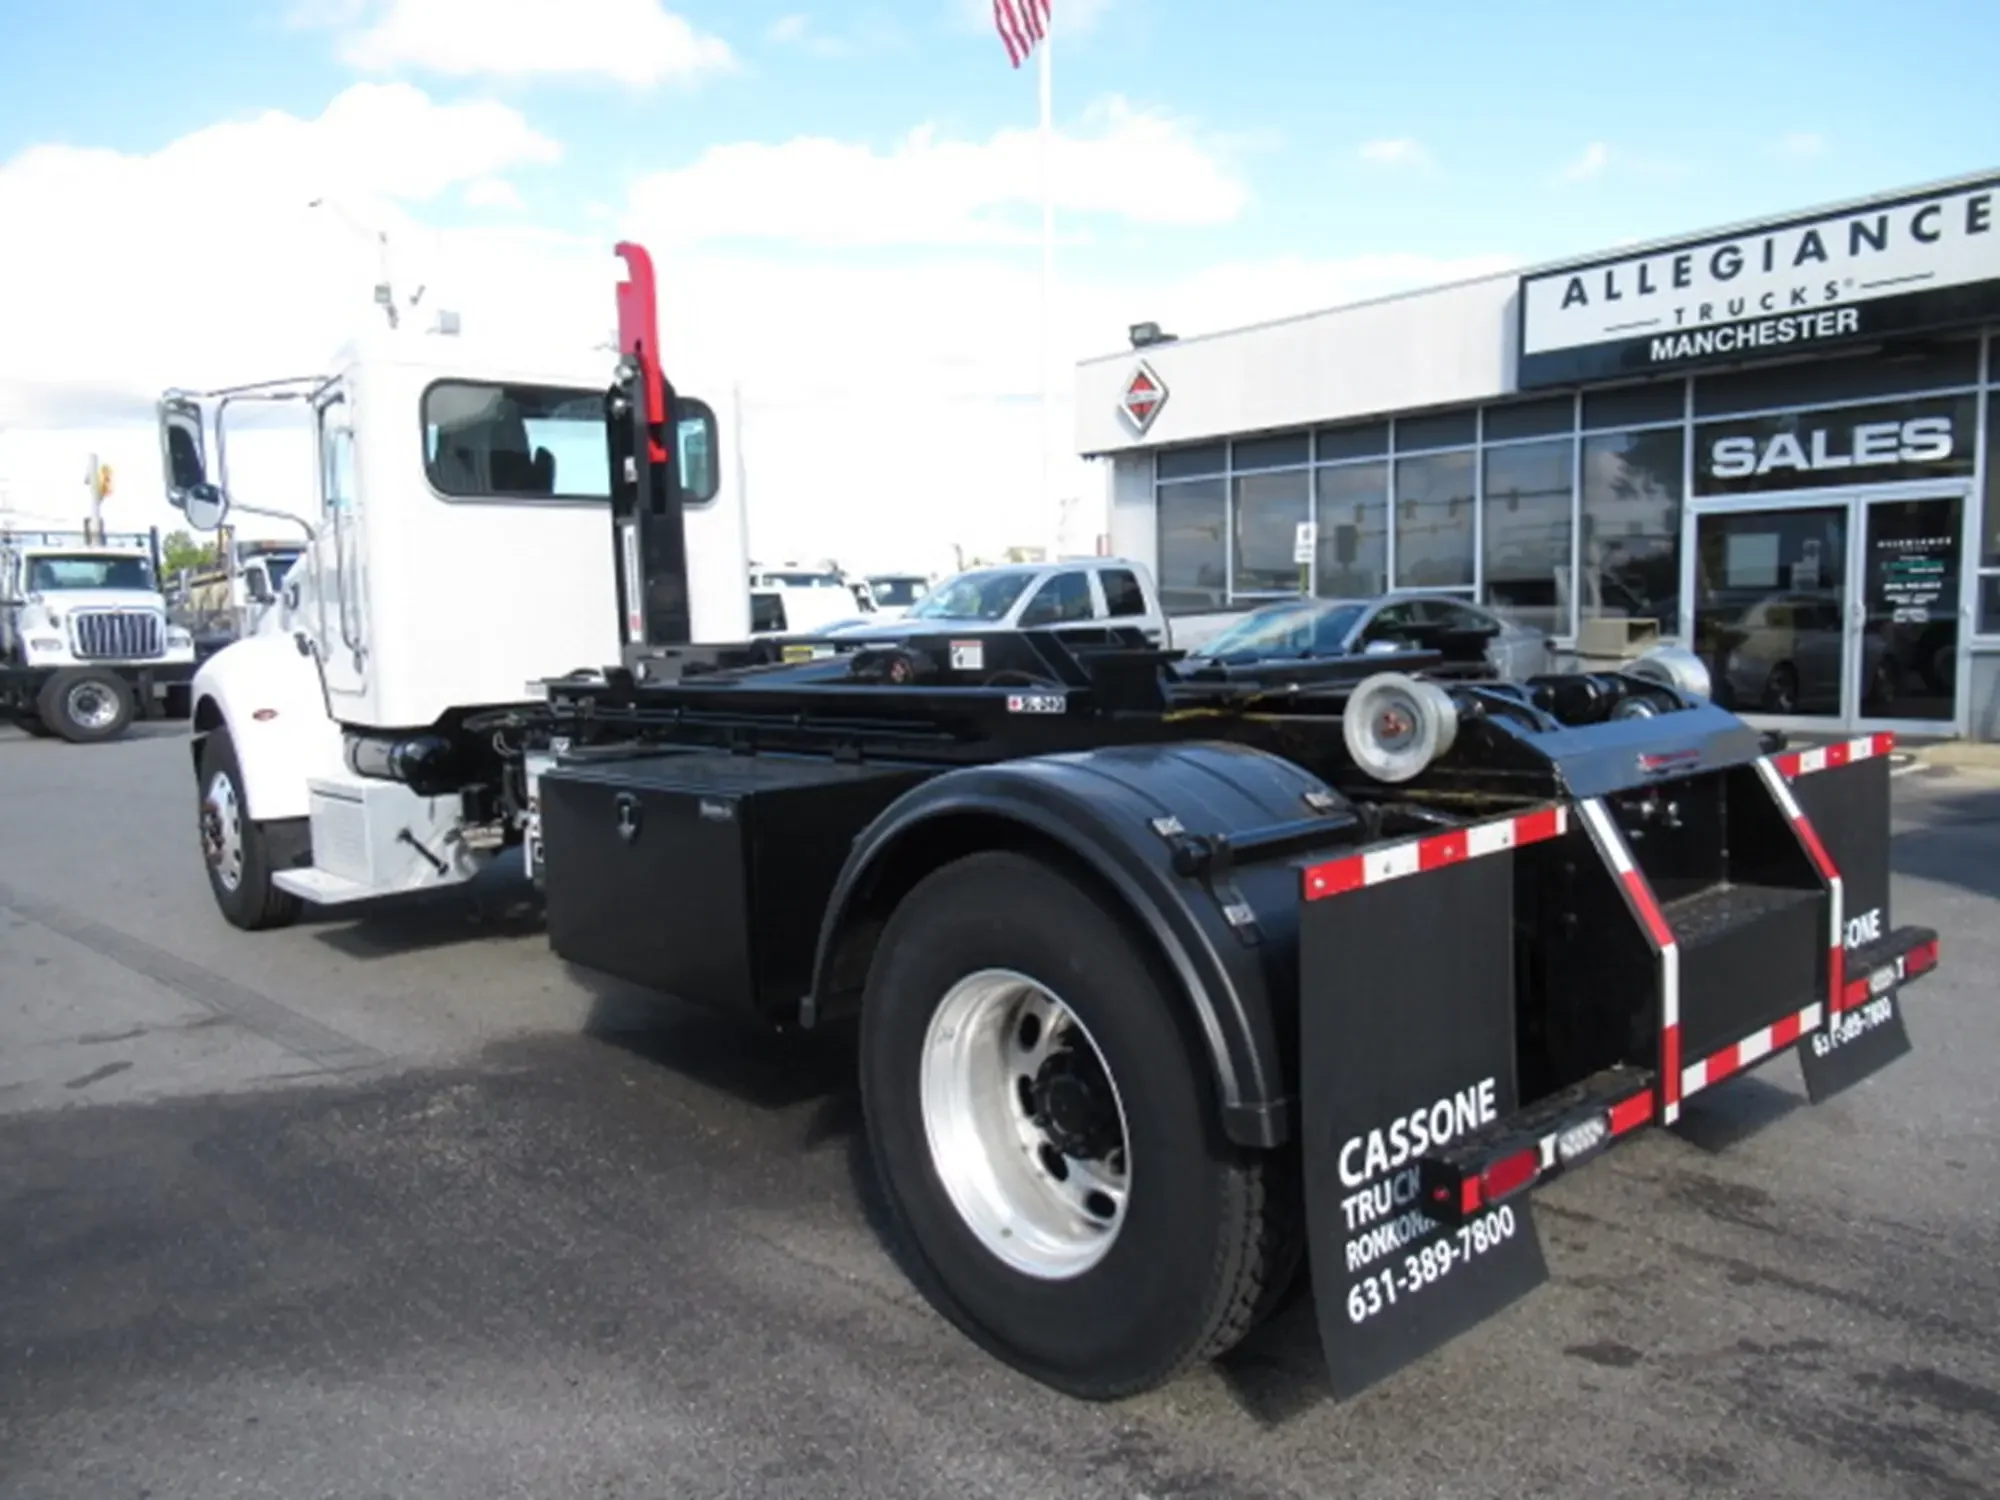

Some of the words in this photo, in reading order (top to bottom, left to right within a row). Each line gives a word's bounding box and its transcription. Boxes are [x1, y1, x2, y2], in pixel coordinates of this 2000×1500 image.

[1560, 194, 1992, 309] ALLEGIANCE
[1650, 307, 1859, 362] MANCHESTER
[1673, 279, 1841, 326] TRUCKS
[1711, 416, 1954, 479] SALES
[1337, 1076, 1497, 1188] CASSONE
[1346, 1204, 1516, 1324] 631-389-7800
